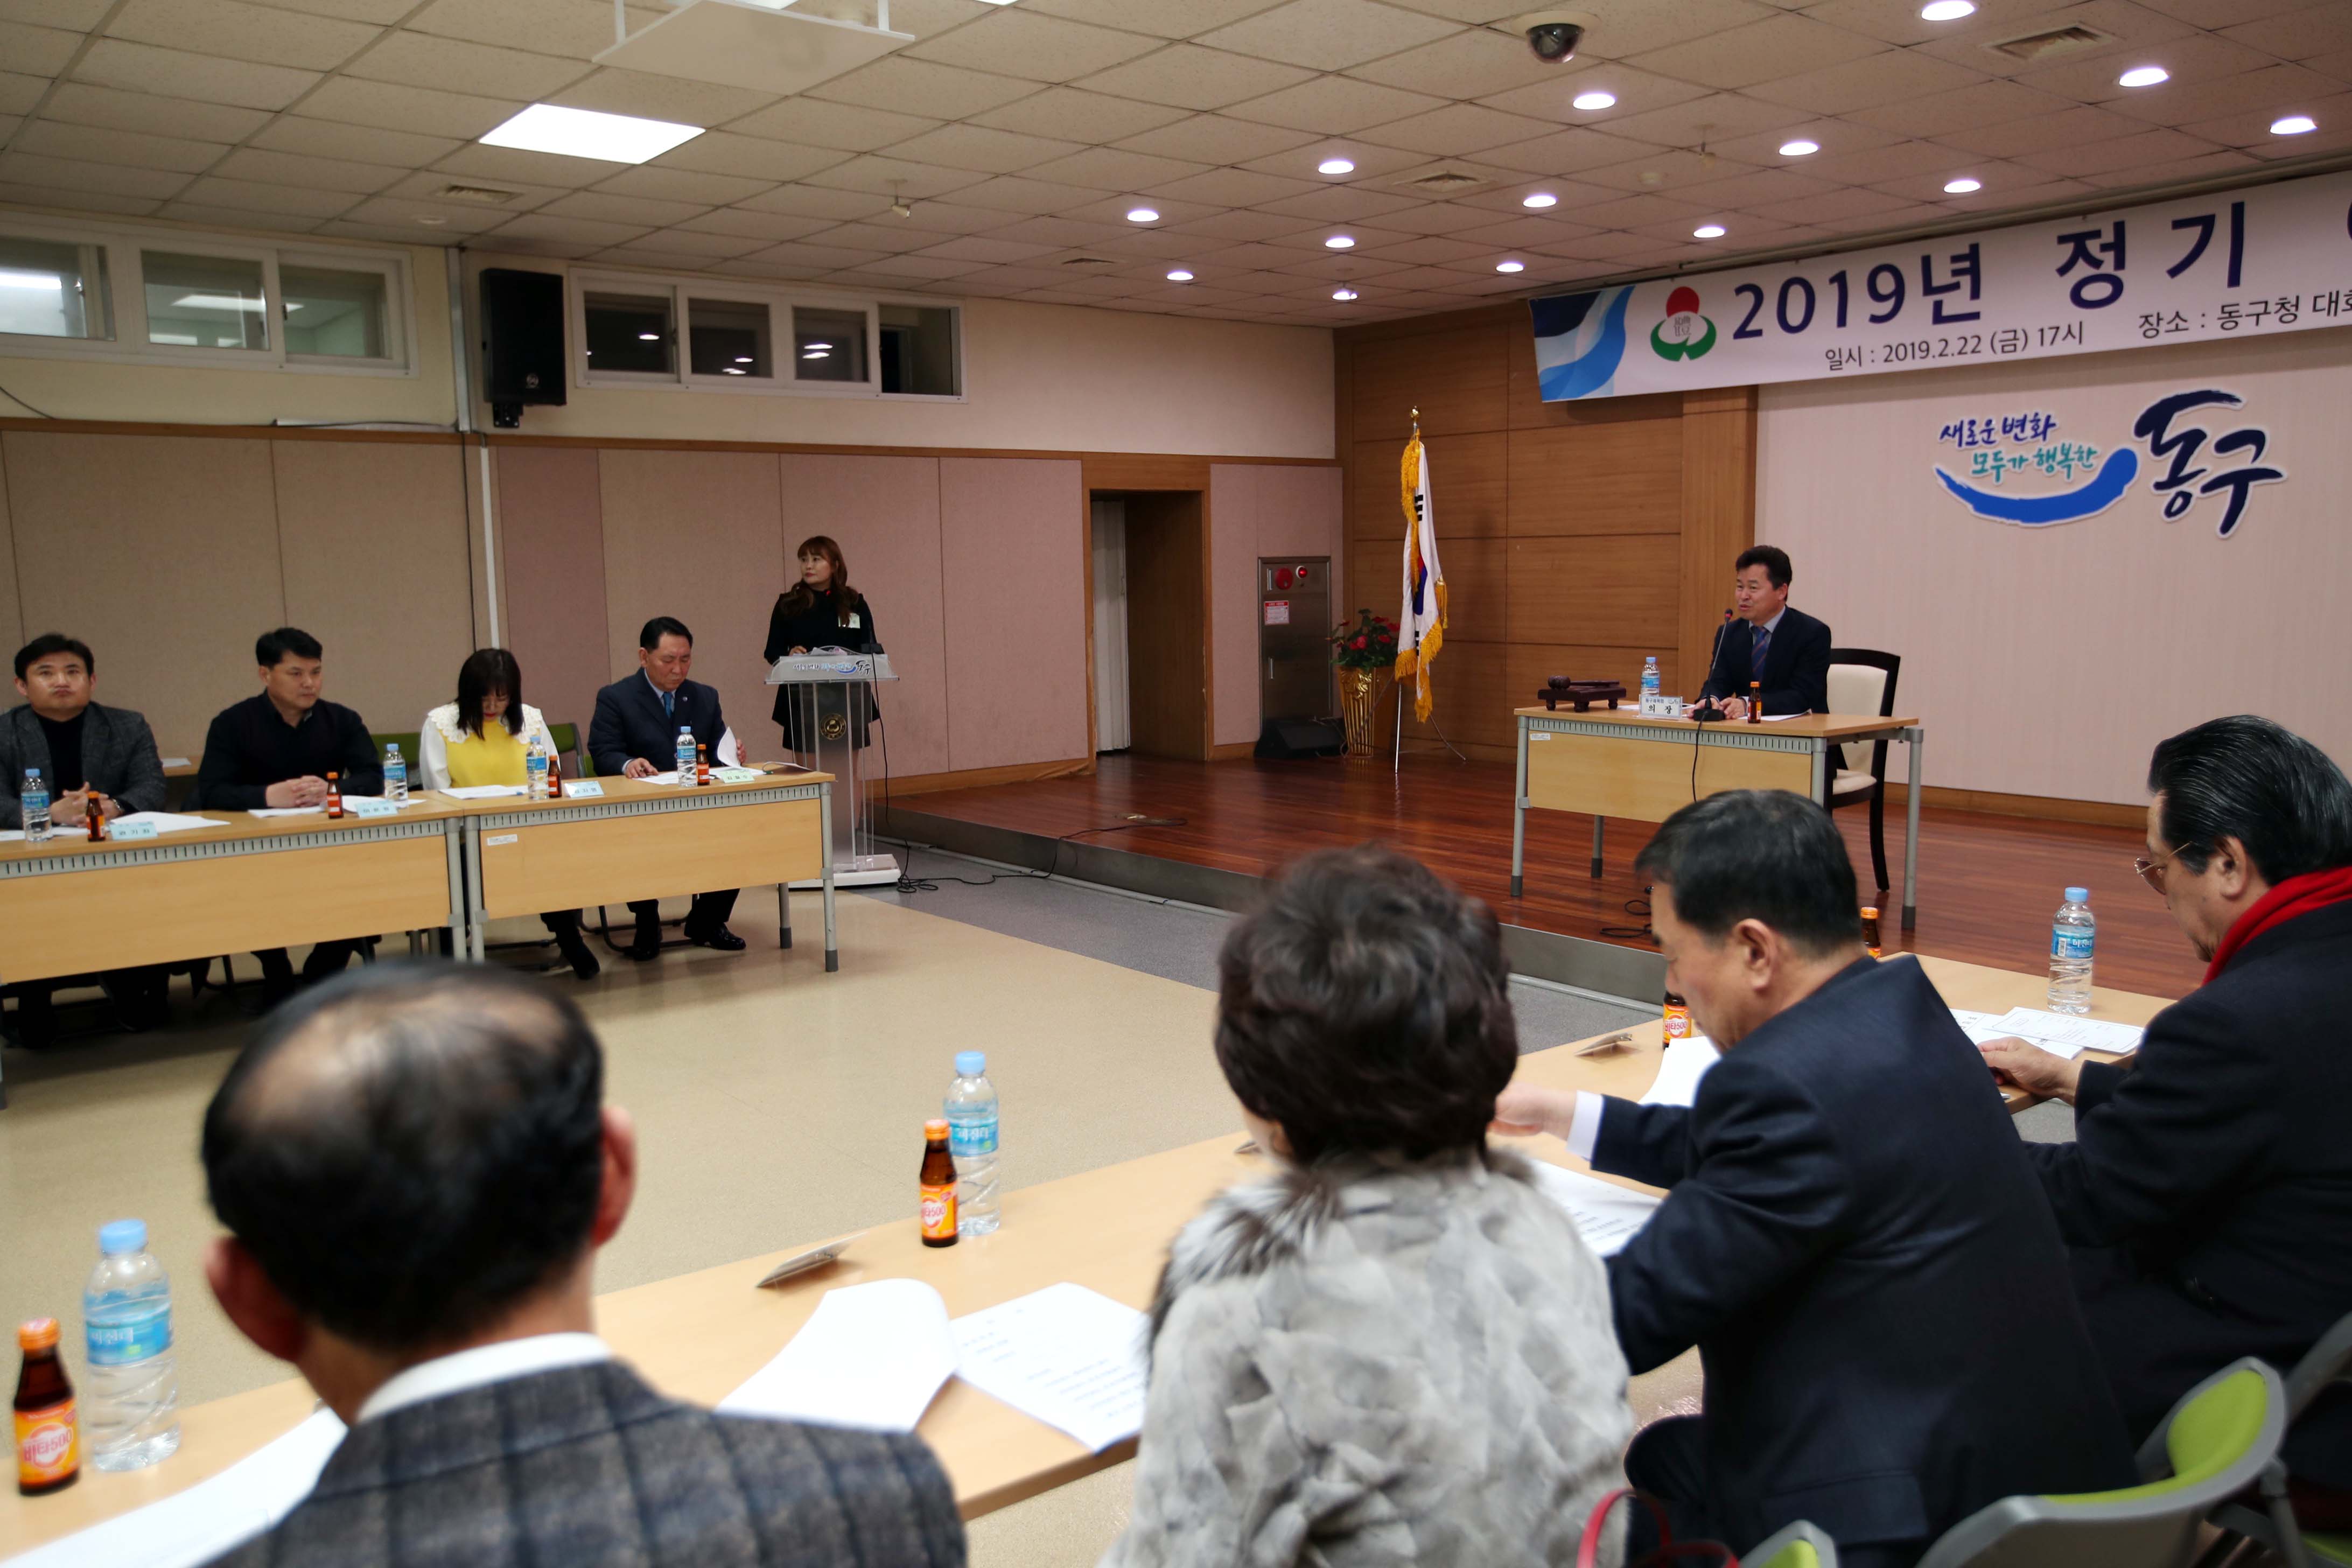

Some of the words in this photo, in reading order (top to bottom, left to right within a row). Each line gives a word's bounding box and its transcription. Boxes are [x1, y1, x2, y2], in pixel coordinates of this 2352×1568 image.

[1732, 242, 1982, 340] 2019년
[2138, 310, 2189, 339] 장소
[2216, 295, 2300, 331] 동구청
[1825, 345, 1862, 371] 일시
[2038, 320, 2083, 347] 17시
[1939, 418, 1997, 448] 새로운
[2001, 412, 2057, 443] 변화
[1971, 450, 2029, 483] 모두가
[2033, 443, 2097, 480] 행복한
[2133, 390, 2284, 535] 동구
